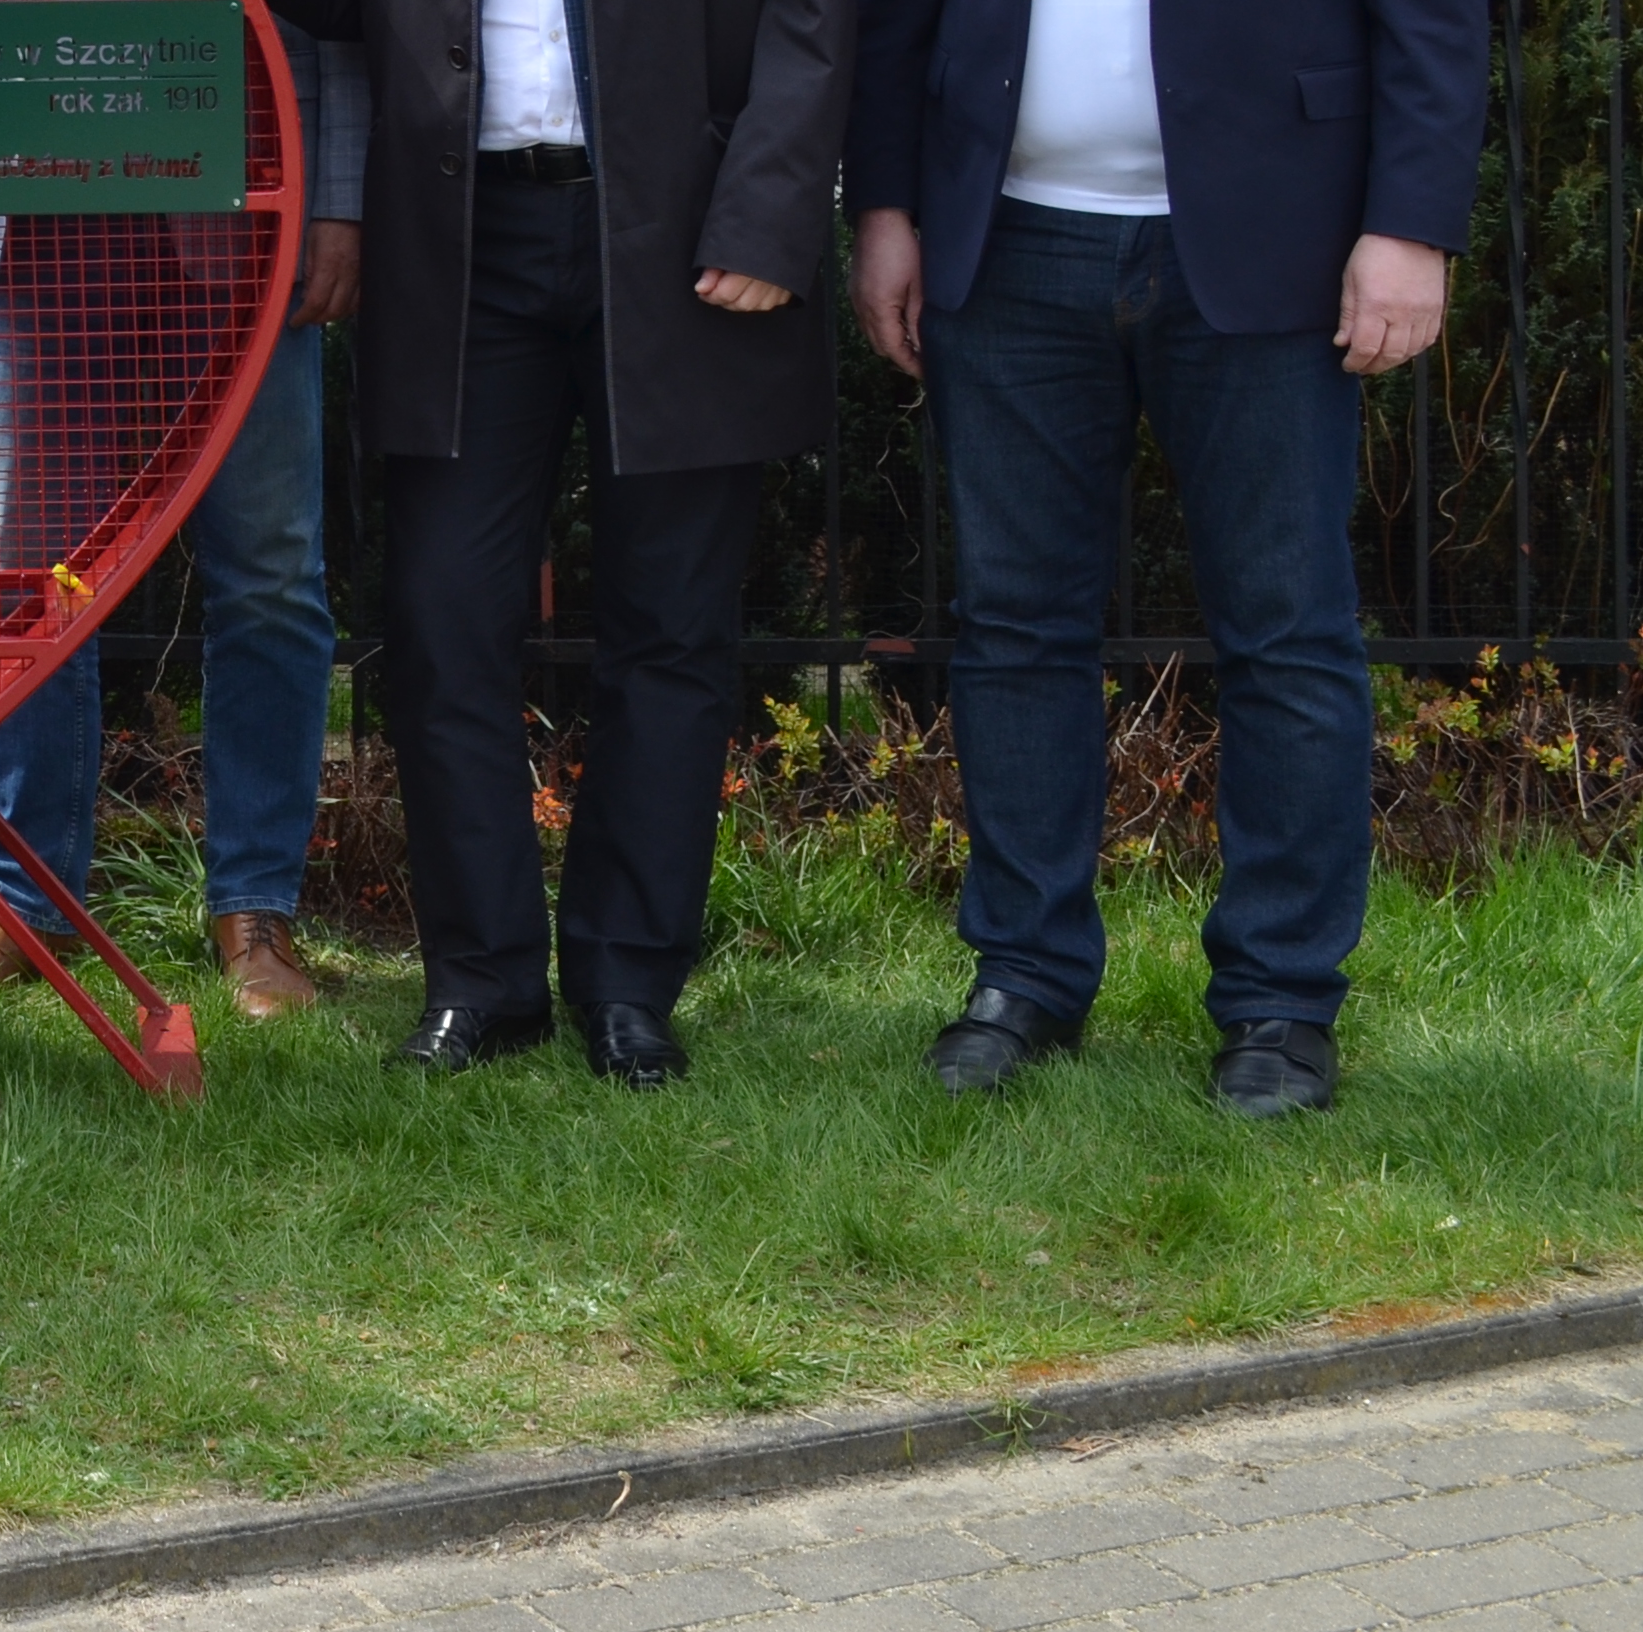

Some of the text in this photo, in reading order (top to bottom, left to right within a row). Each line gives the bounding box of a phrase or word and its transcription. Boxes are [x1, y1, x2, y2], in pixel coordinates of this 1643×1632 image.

[16, 44, 43, 66] w
[55, 35, 217, 71] Szczytnie
[48, 86, 218, 113] rok zał. 1910
[97, 159, 115, 180] z
[122, 151, 203, 180] Wami
